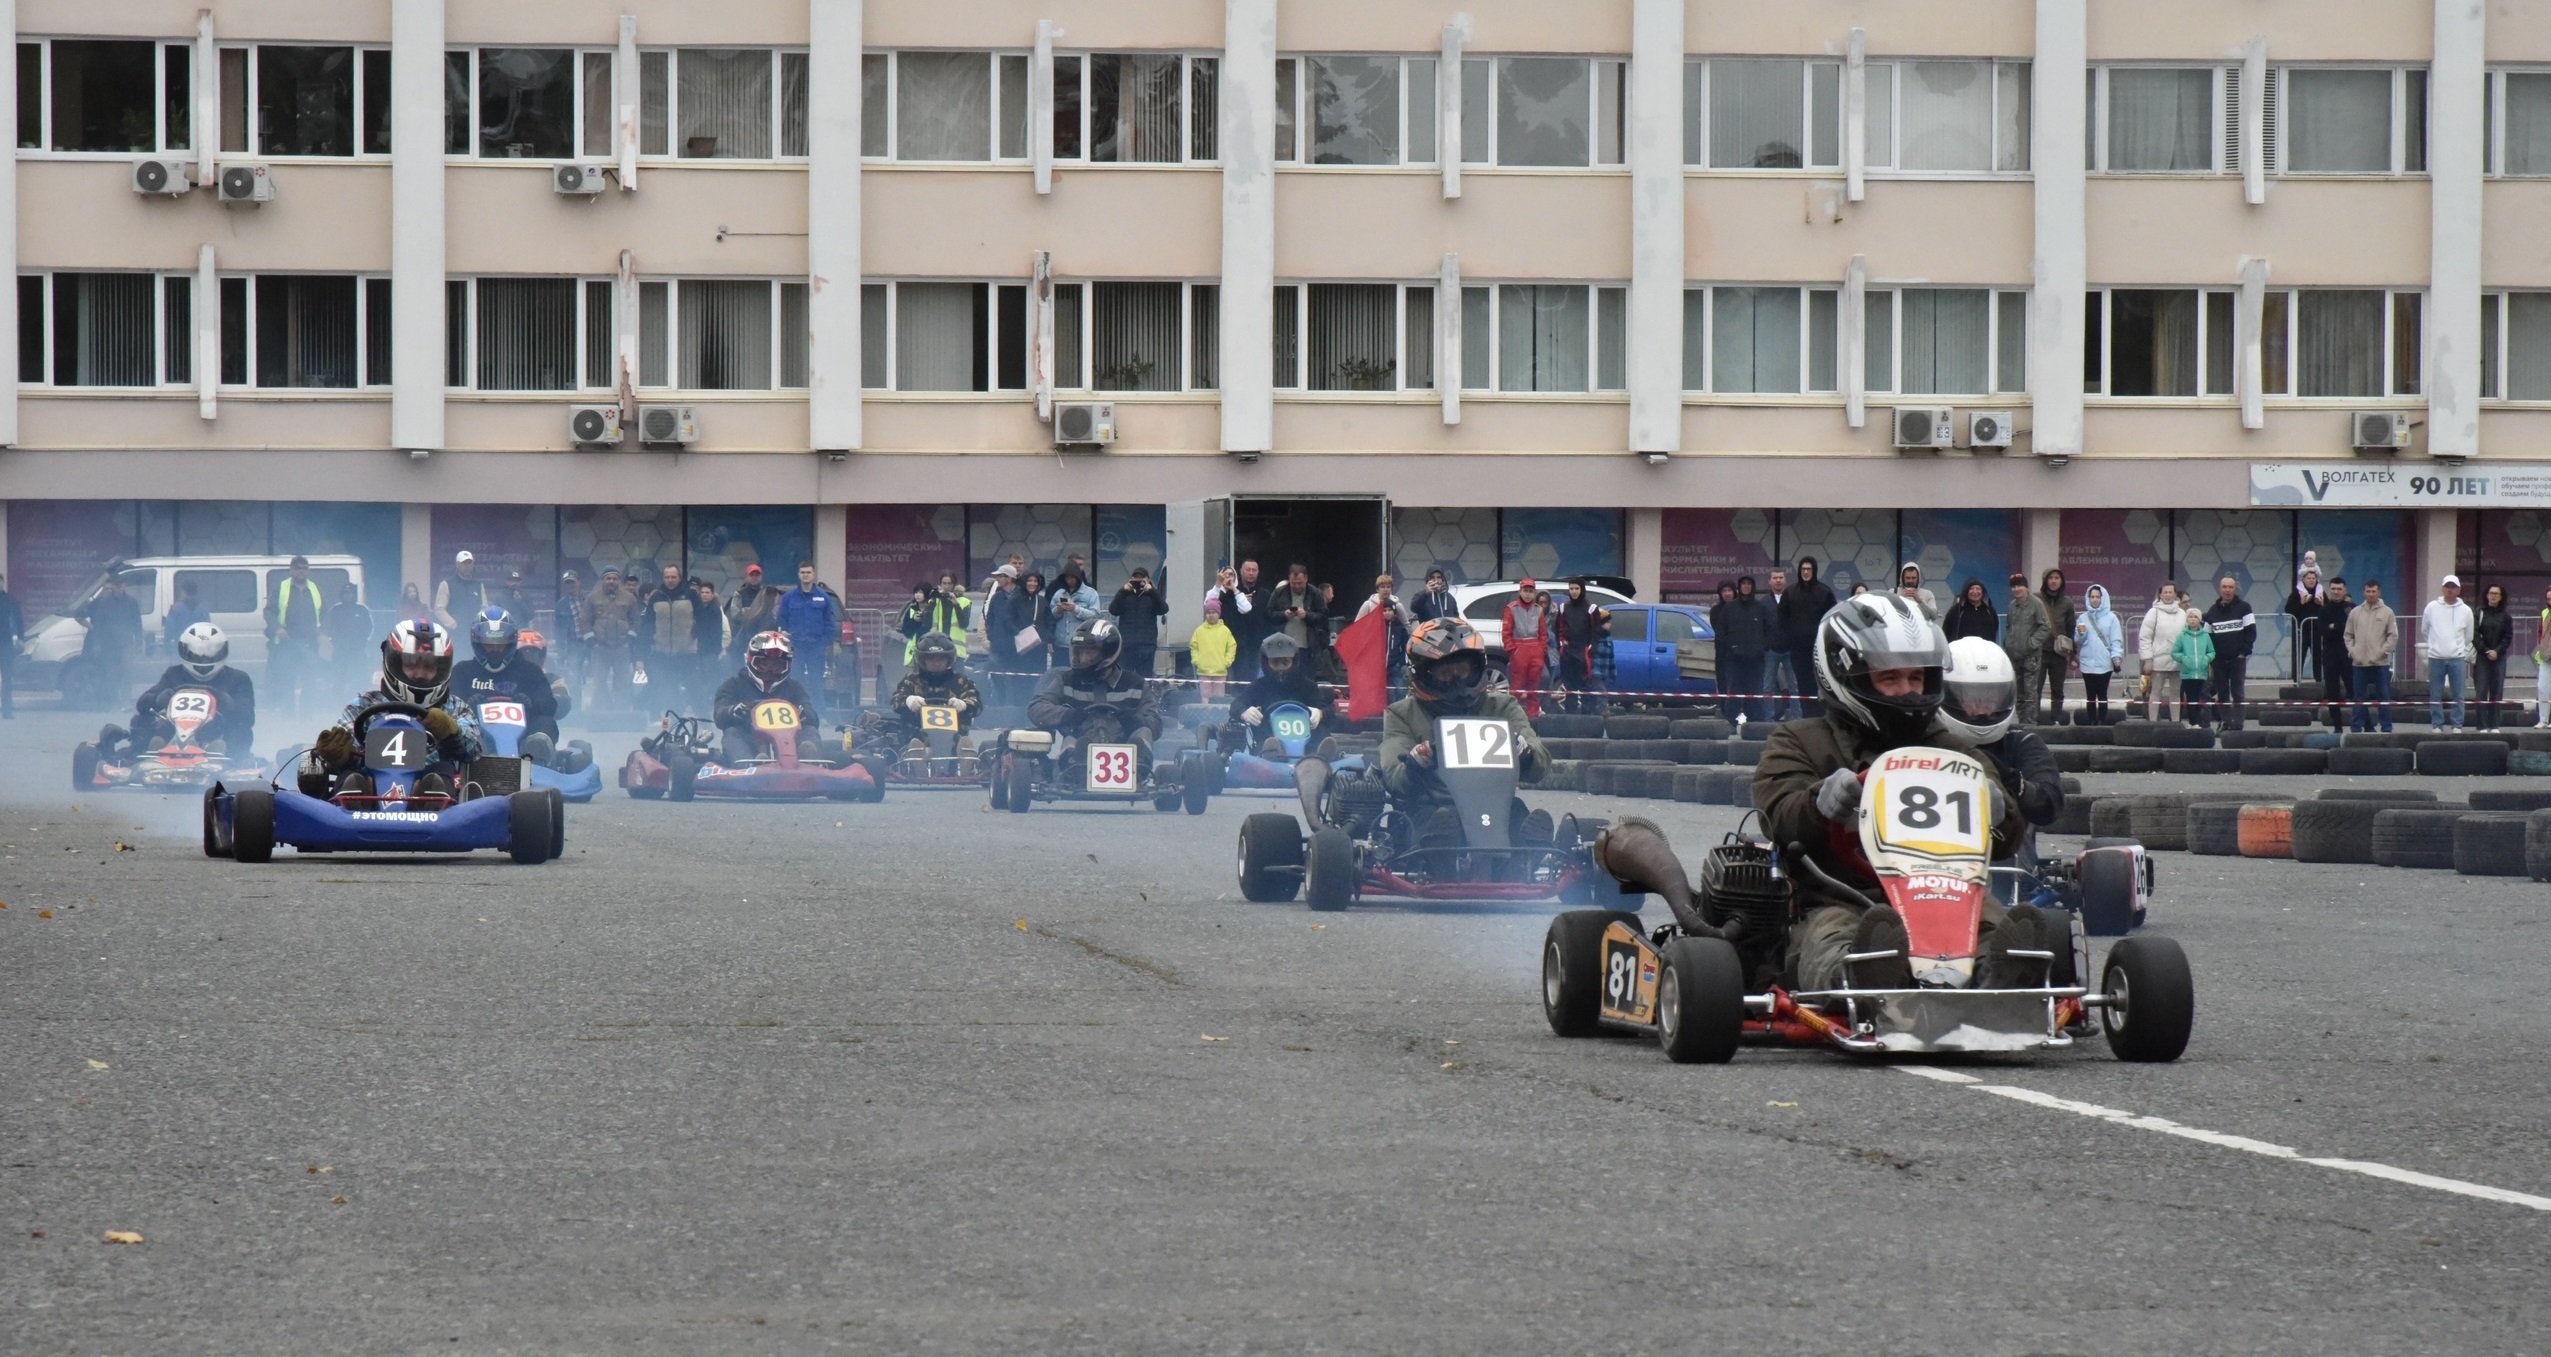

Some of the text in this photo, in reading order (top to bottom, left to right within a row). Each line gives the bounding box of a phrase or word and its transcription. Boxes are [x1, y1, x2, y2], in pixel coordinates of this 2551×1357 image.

[2322, 471, 2396, 483] ВОЛГАТЕХ
[2410, 477, 2490, 495] 90 ЛЕТ
[2501, 483, 2530, 491] обучаем
[848, 542, 942, 552] ЭКОНОМИЧЕСКИЙ
[2060, 546, 2103, 554] КУЛЬТЕТ
[848, 554, 911, 563] ФАКУЛЬТЕТ
[1662, 555, 1726, 564] ФОРМАТИКИ
[2112, 556, 2119, 564] И
[2122, 557, 2156, 565] ПРАВА
[471, 677, 495, 691] fuck
[175, 697, 206, 712] 32
[484, 706, 522, 721] 50
[762, 707, 794, 725] 18
[926, 708, 953, 727] 8
[1278, 719, 1305, 736] 90
[381, 730, 408, 766] 4
[1446, 723, 1511, 765] 12
[1094, 751, 1130, 784] 33
[1898, 785, 1972, 835] 81
[1910, 864, 1964, 874] FREELINE
[2135, 854, 2145, 895] 26
[1609, 951, 1637, 1002] 81
